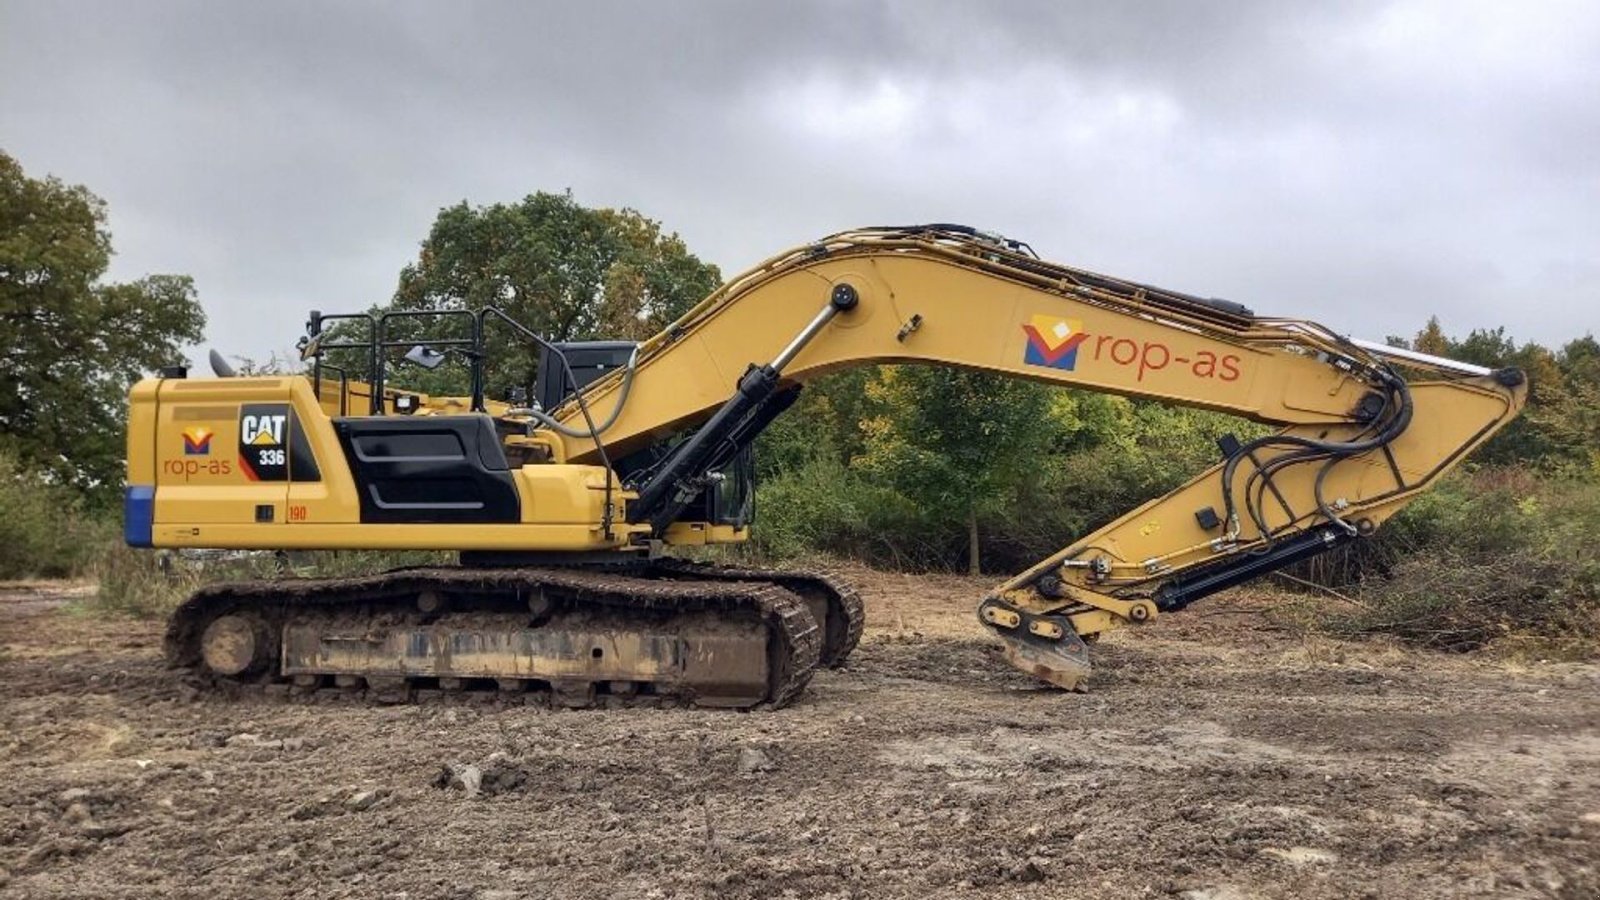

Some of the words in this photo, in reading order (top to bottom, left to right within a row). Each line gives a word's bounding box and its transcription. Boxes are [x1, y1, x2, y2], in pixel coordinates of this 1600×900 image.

[1094, 335, 1241, 382] rop-as
[242, 415, 286, 445] CAT
[259, 449, 285, 465] 336
[163, 458, 231, 482] rop-as
[289, 506, 306, 521] 190
